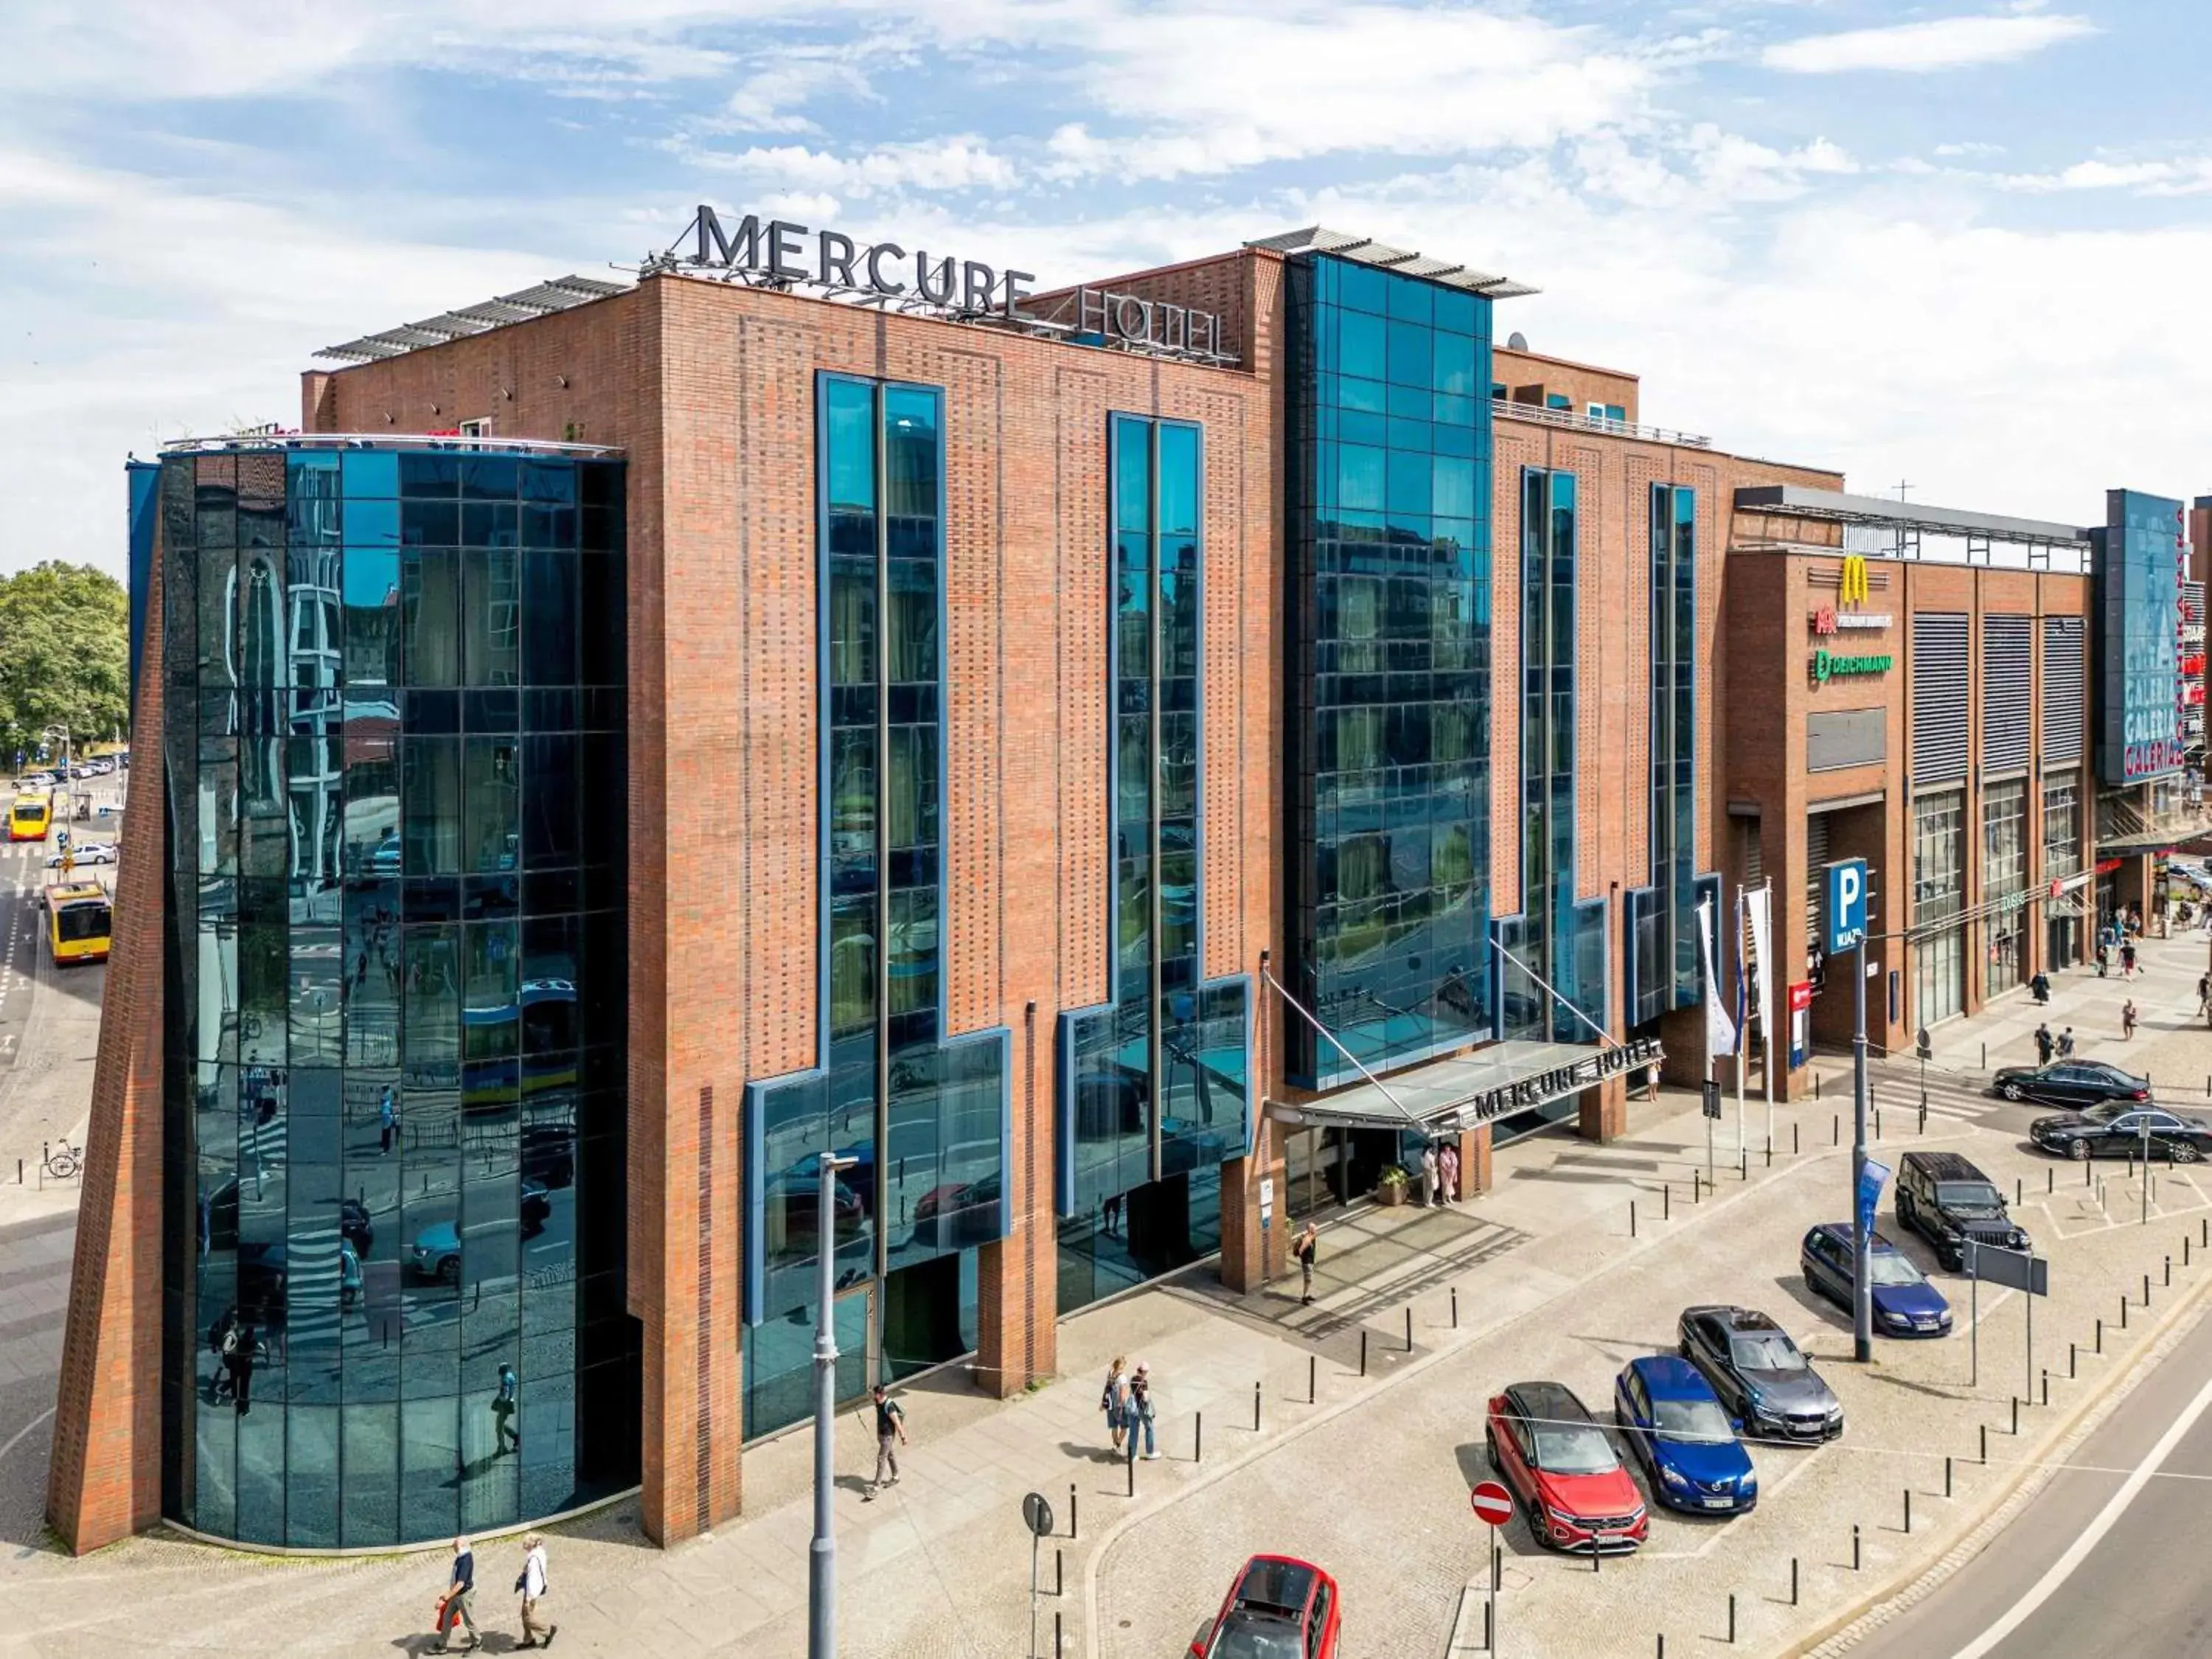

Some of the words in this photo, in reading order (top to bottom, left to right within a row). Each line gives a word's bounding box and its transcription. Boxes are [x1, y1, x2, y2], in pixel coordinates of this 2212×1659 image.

[698, 205, 1035, 320] MERCURE
[1077, 285, 1236, 358] HOTEL
[1832, 655, 1893, 674] DEICHMANN
[2125, 708, 2175, 745] GALERIA
[2126, 739, 2176, 776] GALERIA
[1840, 867, 1860, 928] P
[1837, 928, 1863, 947] WJAZ
[1475, 1065, 1579, 1119] MERCURE
